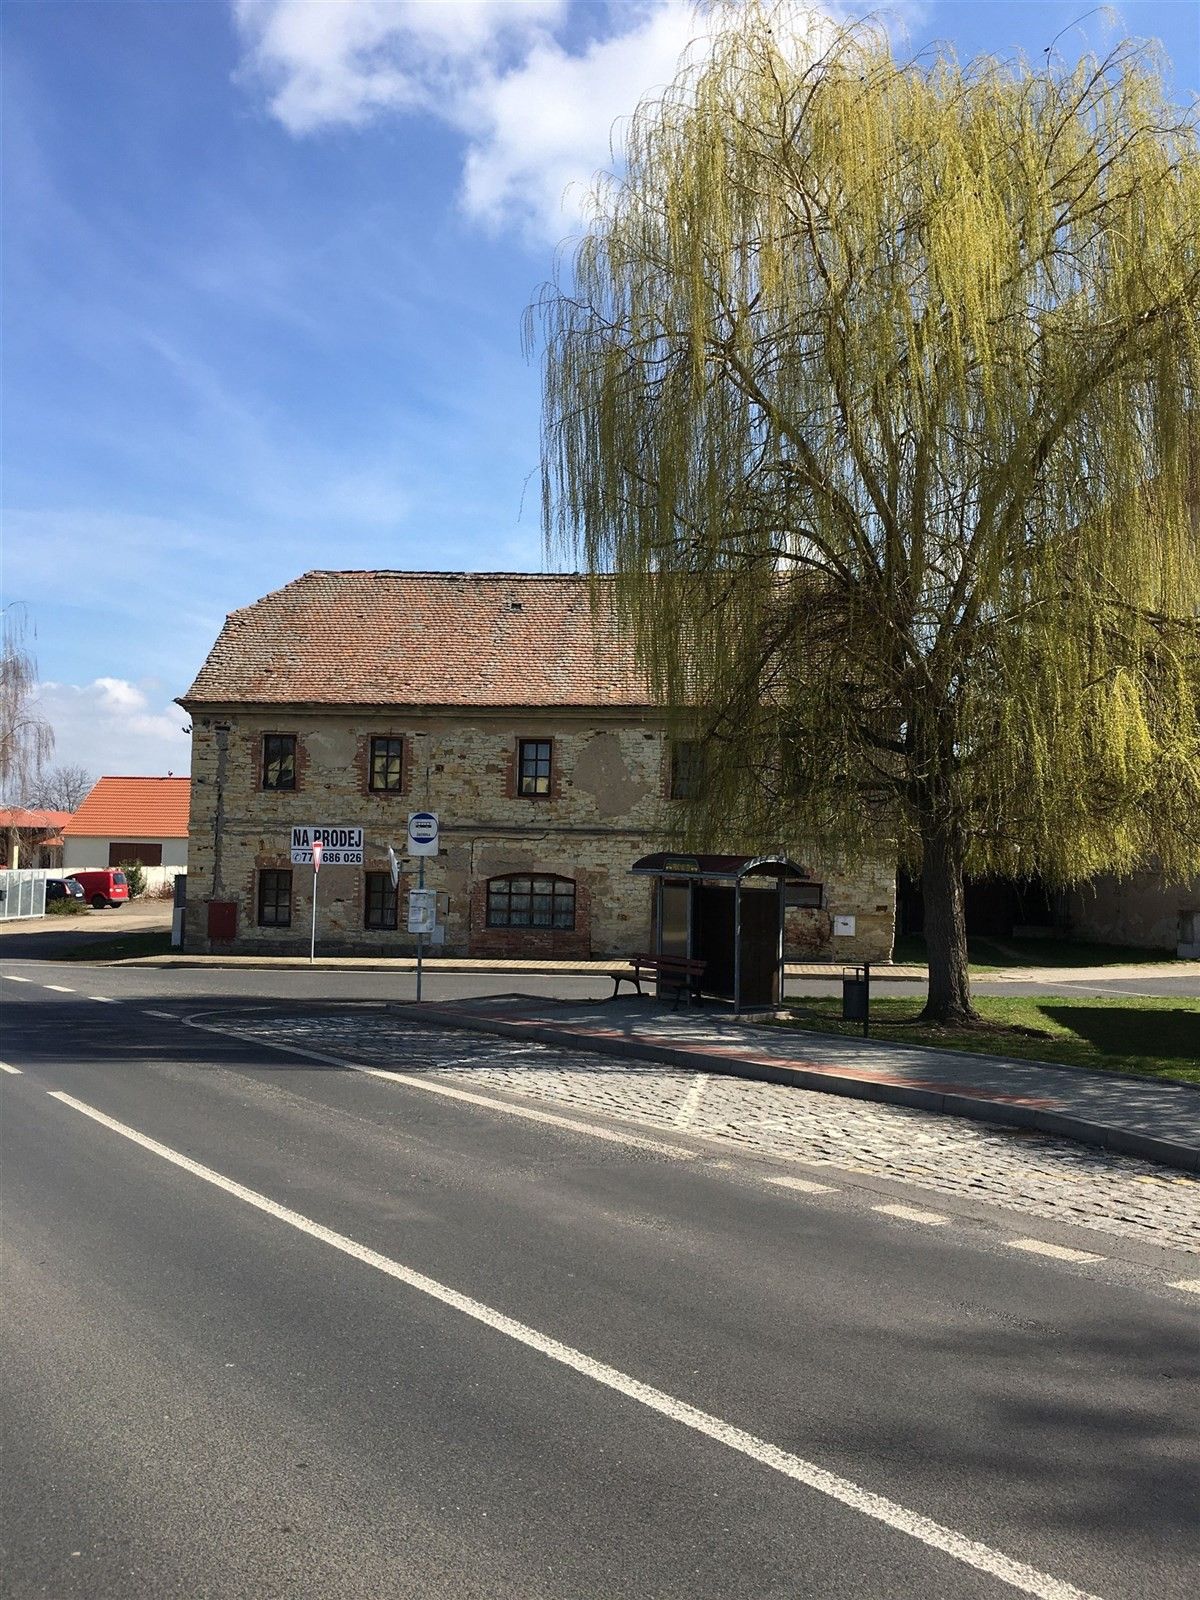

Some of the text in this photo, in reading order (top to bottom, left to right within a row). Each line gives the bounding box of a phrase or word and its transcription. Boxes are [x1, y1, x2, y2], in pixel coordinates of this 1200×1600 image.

[293, 829, 362, 847] NA PRODEJ
[302, 852, 362, 863] 77 686 026
